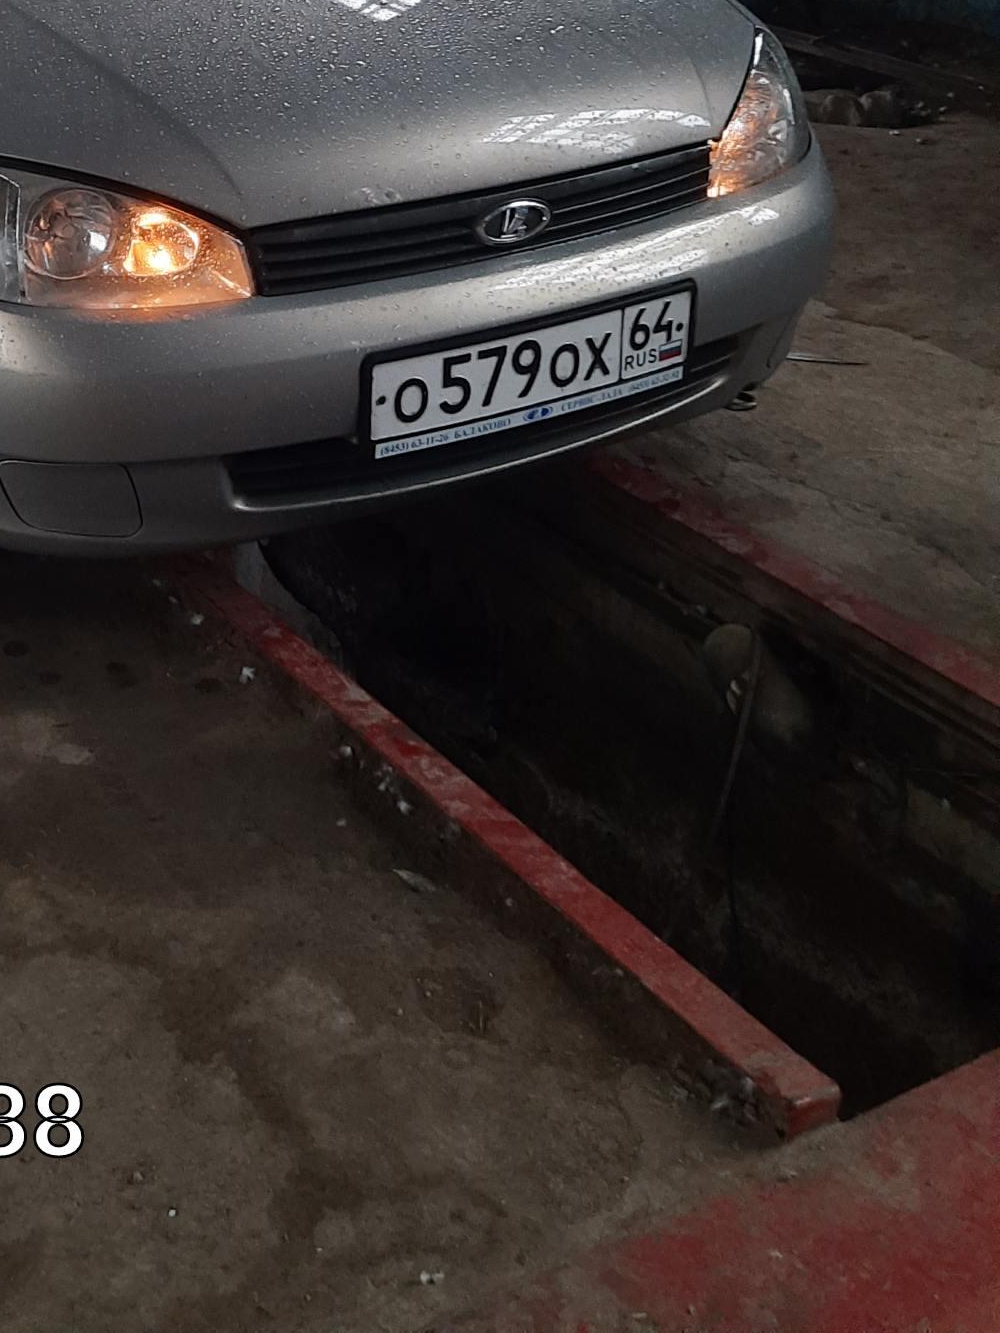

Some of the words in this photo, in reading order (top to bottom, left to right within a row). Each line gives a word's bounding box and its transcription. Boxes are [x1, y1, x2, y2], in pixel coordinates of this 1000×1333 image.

[629, 300, 674, 351] 64
[394, 332, 612, 423] О579ОХ
[624, 349, 657, 371] RUS
[454, 418, 511, 439] БАЛАКОВО
